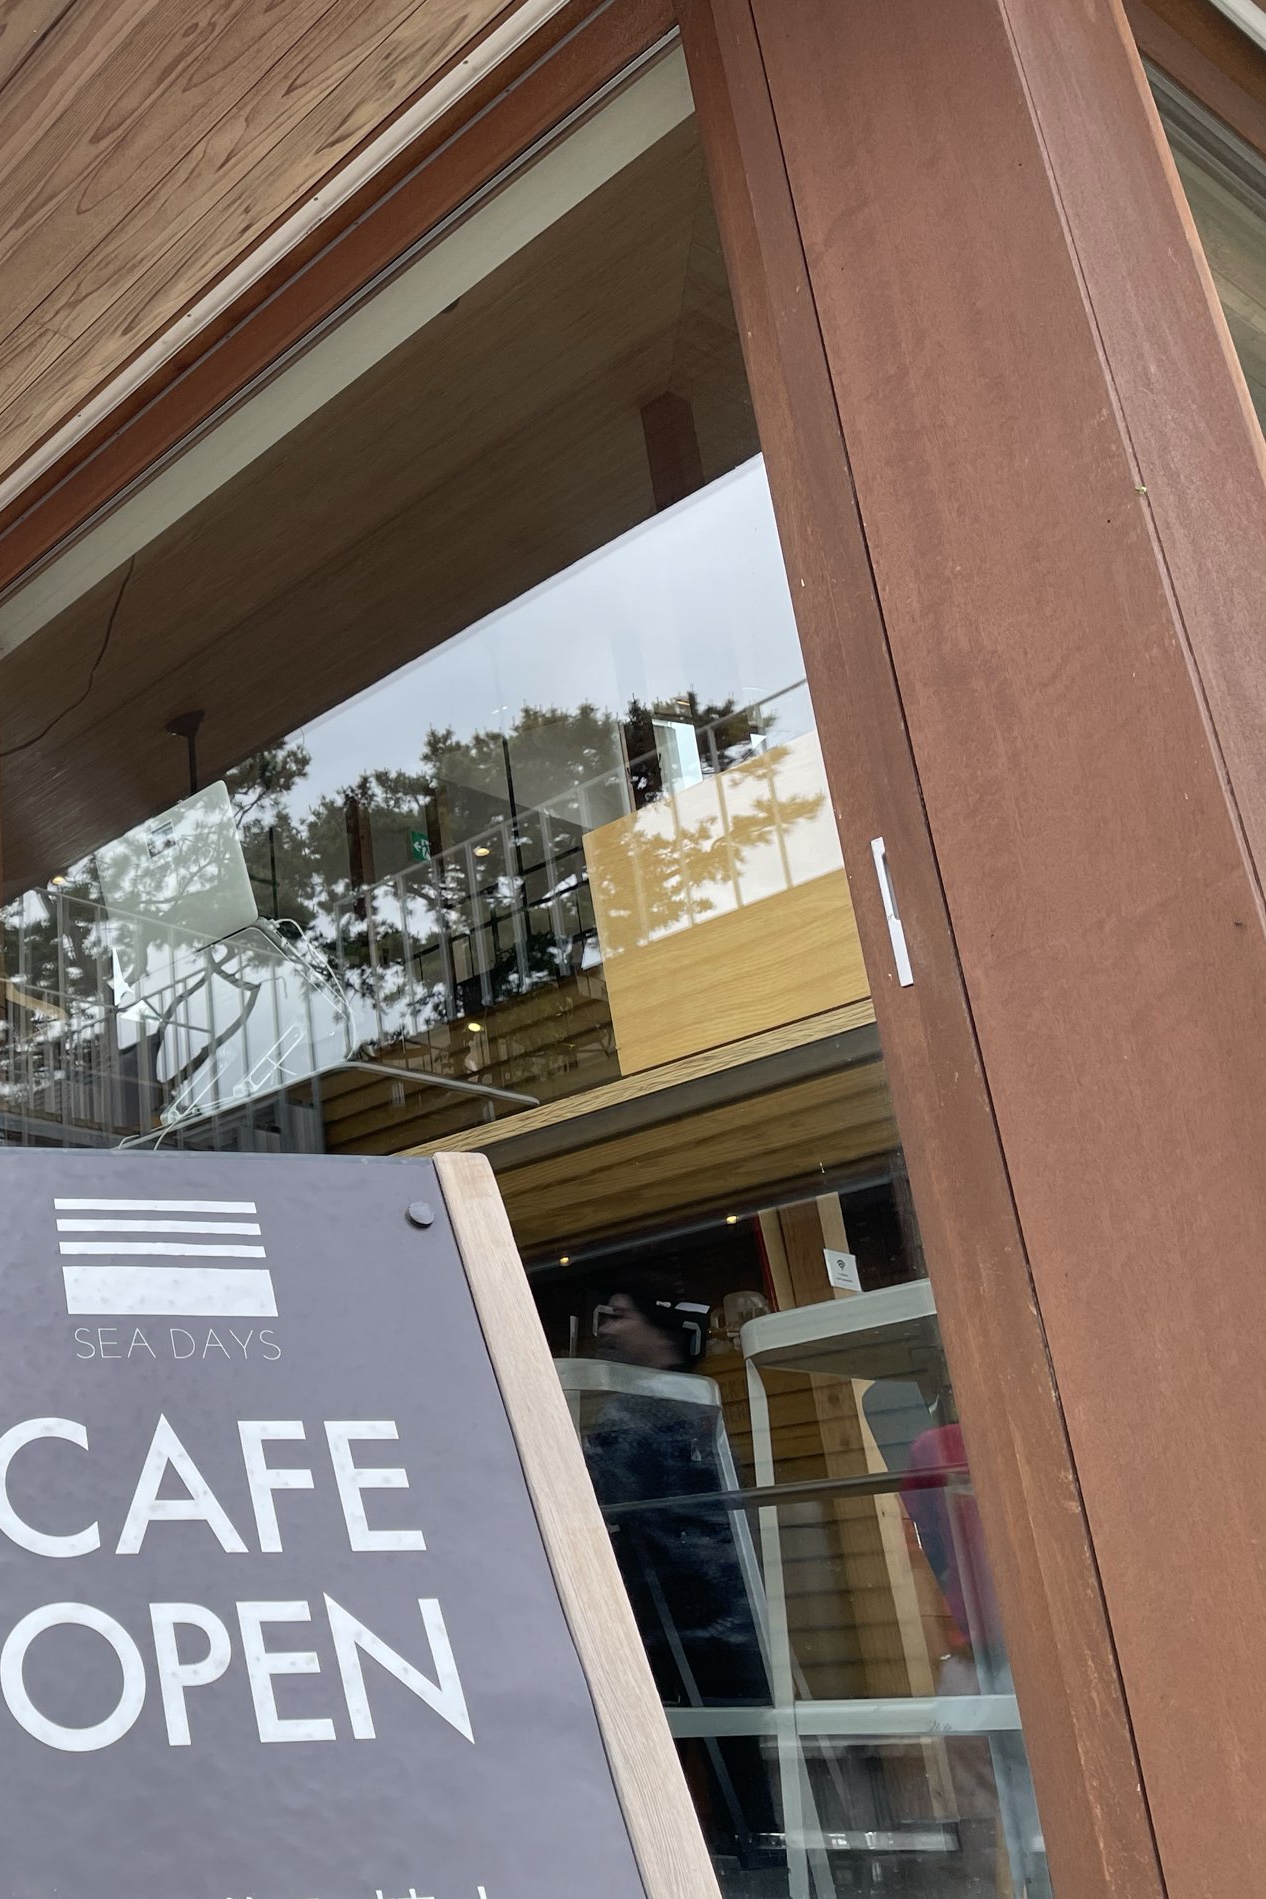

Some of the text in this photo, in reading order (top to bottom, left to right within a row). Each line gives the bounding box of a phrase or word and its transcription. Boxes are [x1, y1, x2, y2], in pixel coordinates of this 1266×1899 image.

[74, 1327, 282, 1361] SEA DAYS
[0, 1591, 475, 1752] OPEN
